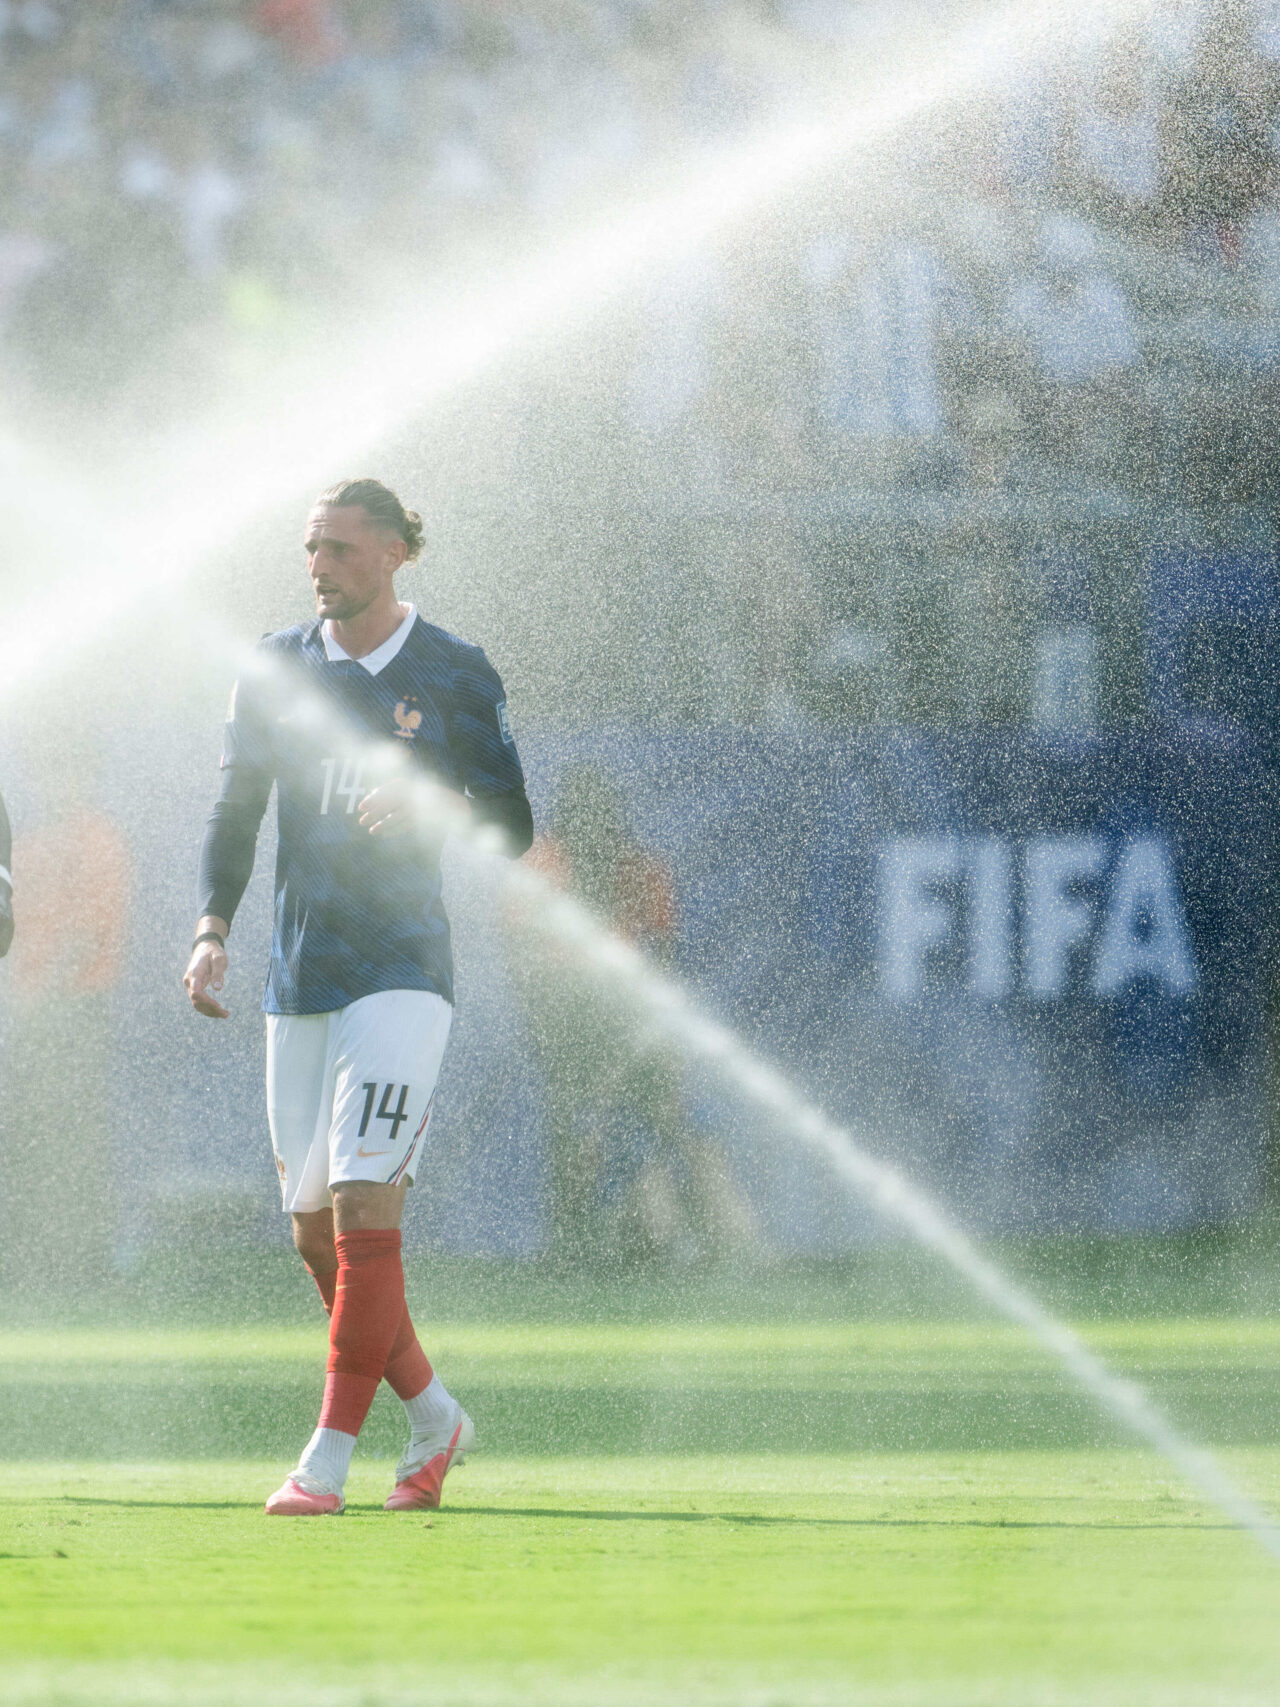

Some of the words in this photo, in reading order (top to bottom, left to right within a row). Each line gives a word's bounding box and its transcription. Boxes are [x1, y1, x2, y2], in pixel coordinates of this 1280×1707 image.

[320, 758, 367, 815] 14
[878, 835, 1198, 1000] FIFA
[357, 1082, 409, 1140] 14
